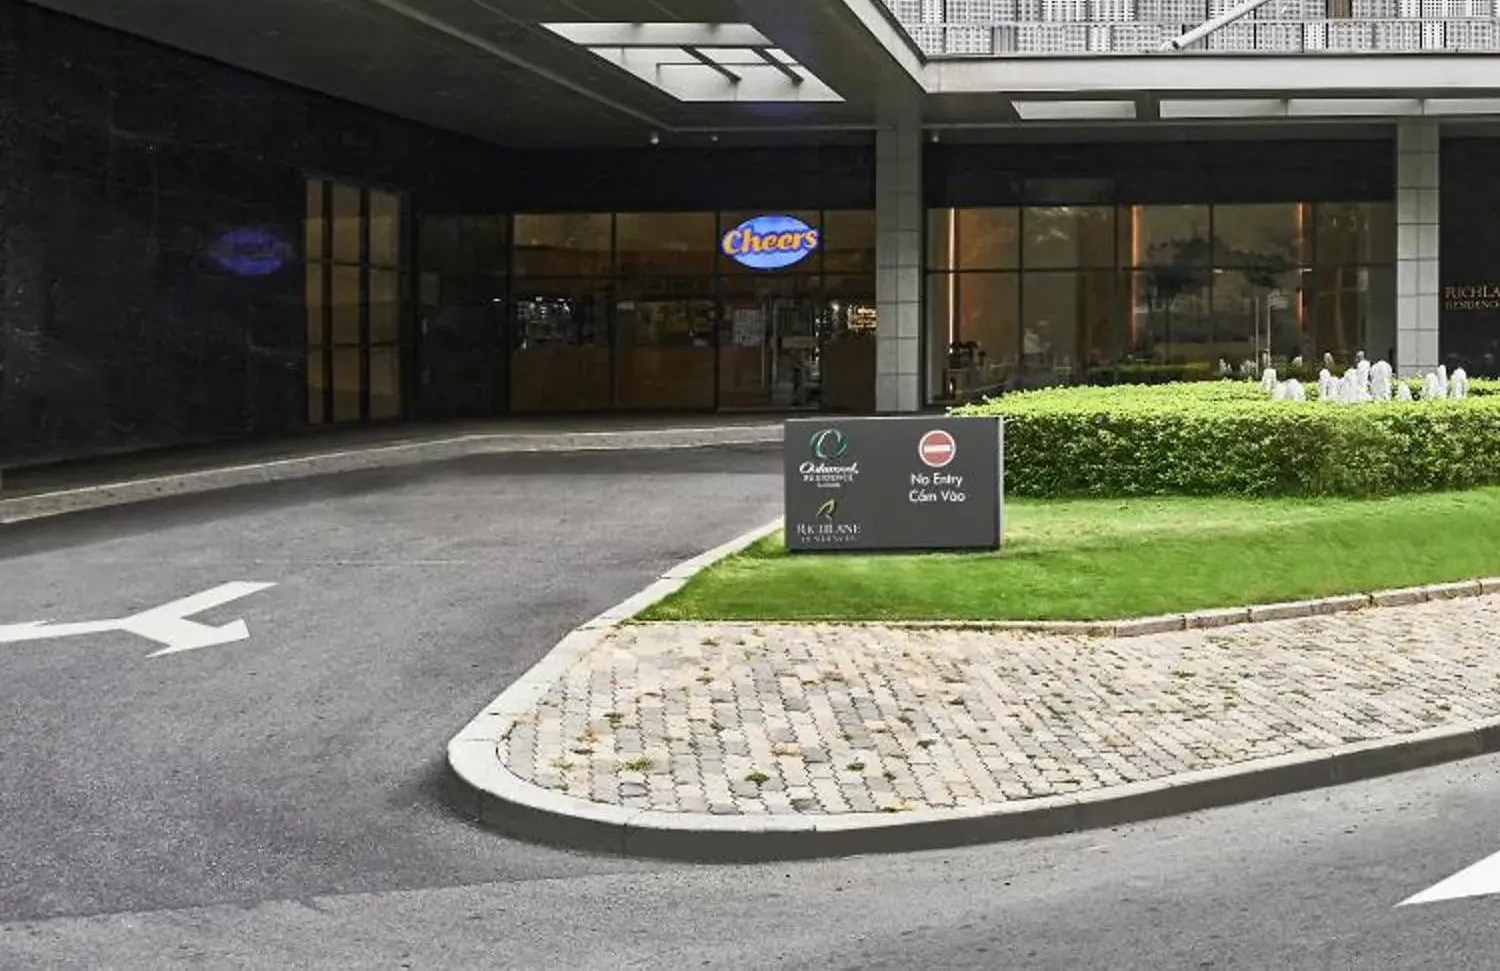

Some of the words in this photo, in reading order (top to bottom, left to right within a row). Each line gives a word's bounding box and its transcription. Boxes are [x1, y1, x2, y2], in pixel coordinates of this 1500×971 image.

[721, 227, 819, 256] Cheers
[910, 472, 930, 486] No
[933, 472, 963, 488] Entry
